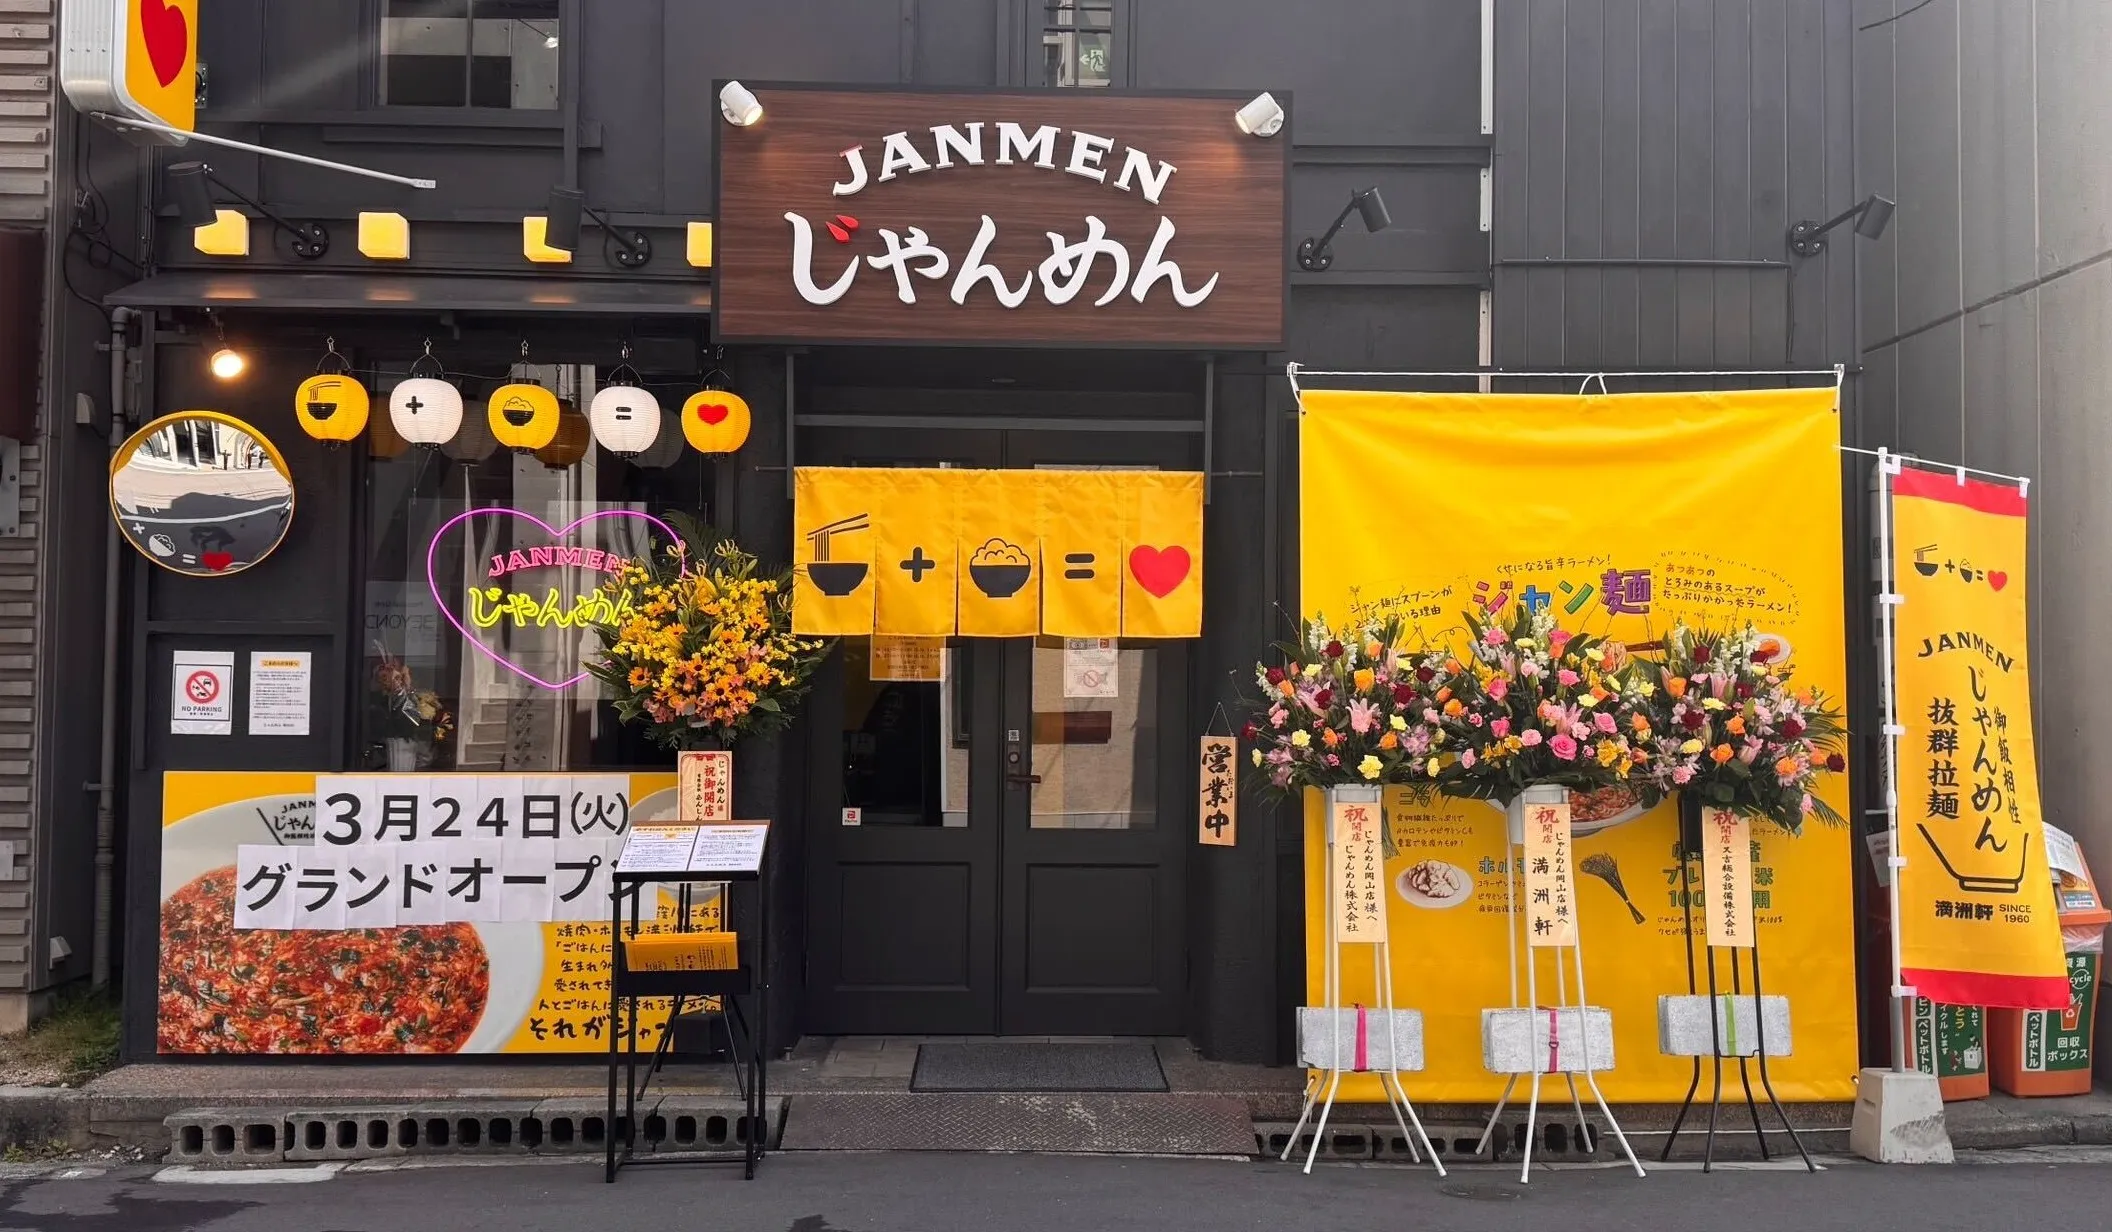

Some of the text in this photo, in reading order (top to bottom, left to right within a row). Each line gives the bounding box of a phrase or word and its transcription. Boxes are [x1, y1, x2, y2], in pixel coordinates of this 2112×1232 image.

[833, 121, 1178, 205] JANMEN
[784, 211, 1220, 309] じゃんめん
[488, 545, 631, 580] JANMEN
[1665, 563, 1716, 577] あつあつの
[1665, 577, 1766, 597] とろみのあるスープが
[468, 586, 635, 629] じゃんめん
[1350, 585, 1453, 613] ジャン麺にスプーンが
[1473, 568, 1652, 617] ジャン麺
[1917, 631, 2014, 673] JANMEN
[1926, 697, 1960, 820] 抜群拉麺
[1968, 665, 2008, 853] じゃんめん
[1994, 706, 2021, 825] 御飯相性
[704, 765, 716, 817] 祝御開店
[1201, 743, 1233, 839] 営業中
[1345, 845, 1359, 932] じゃんめん株式会社
[1364, 830, 1378, 921] じゃんめん岡山店様へ
[1532, 857, 1553, 936] 満洲軒
[1555, 832, 1569, 924] じゃんめん岡山店様へ
[1999, 904, 2032, 914] SINCE
[2003, 914, 2030, 924] 1960
[1918, 1020, 1931, 1073] ペットボトル
[2028, 1013, 2040, 1068] ペットボトル
[2047, 1048, 2088, 1062] ボックス
[2057, 1036, 2081, 1048] 回収
